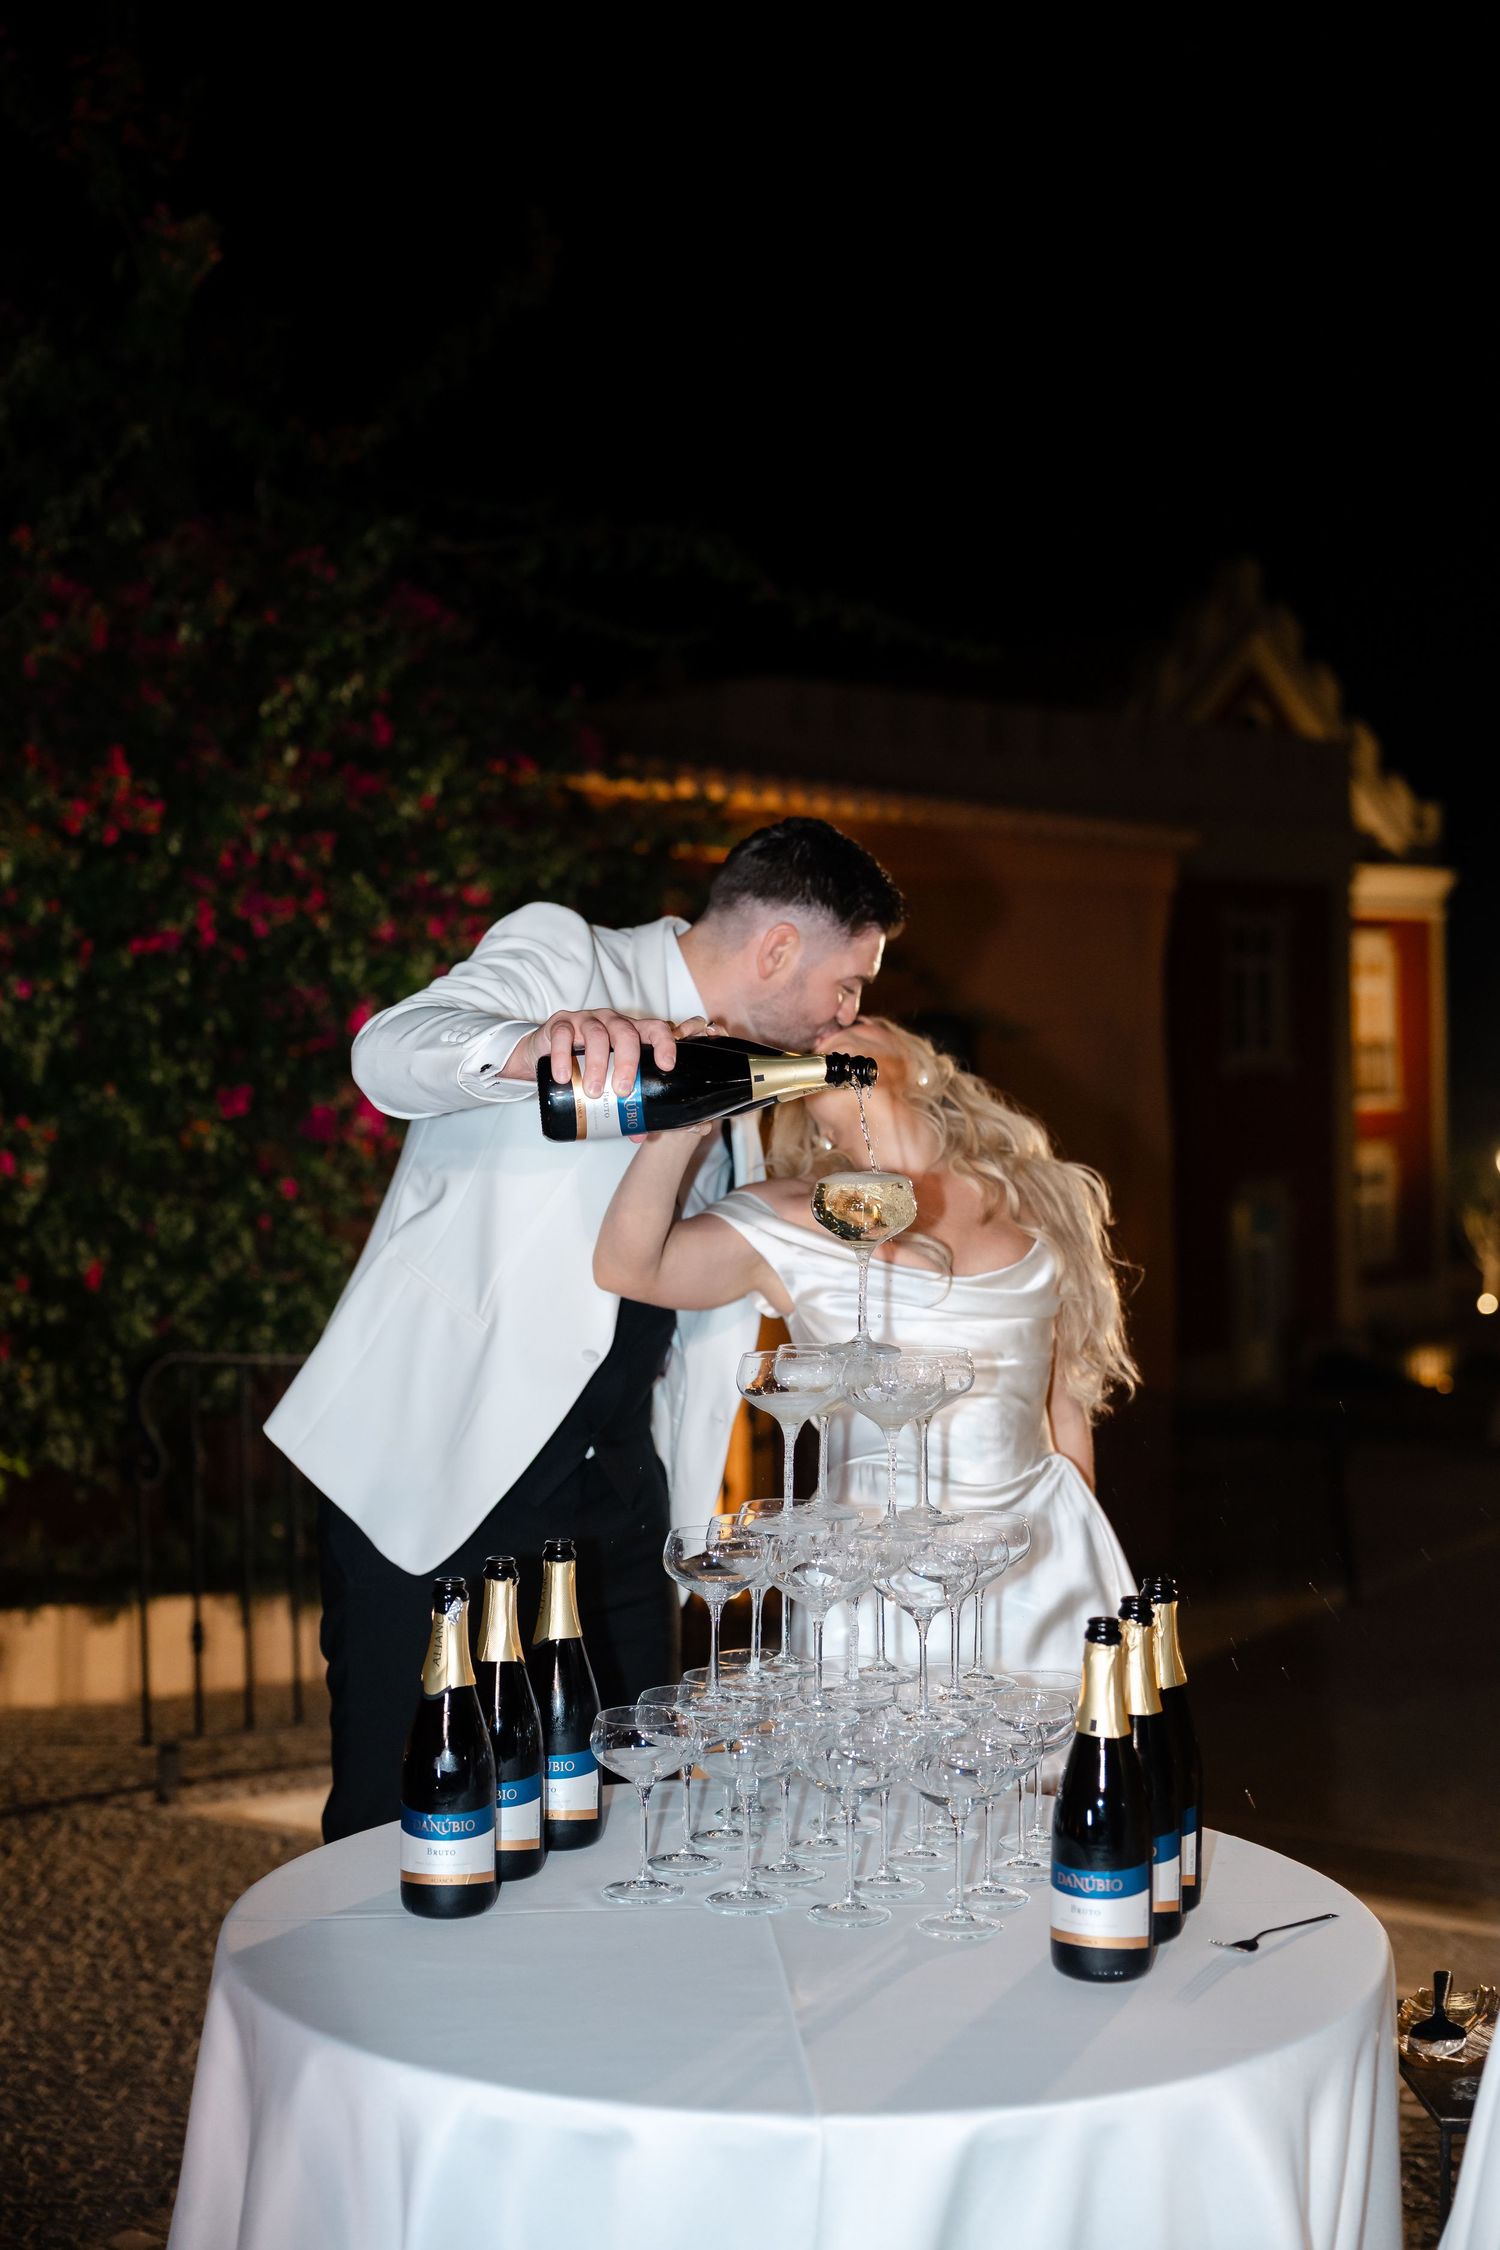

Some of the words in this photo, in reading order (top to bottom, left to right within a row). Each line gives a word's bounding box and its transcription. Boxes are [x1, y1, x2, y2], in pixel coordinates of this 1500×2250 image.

[624, 1088, 640, 1129] NÚBIO
[433, 1612, 444, 1668] ALIANC
[413, 1815, 476, 1836] DANÚBIO
[1057, 1871, 1124, 1894] DANÚBIO
